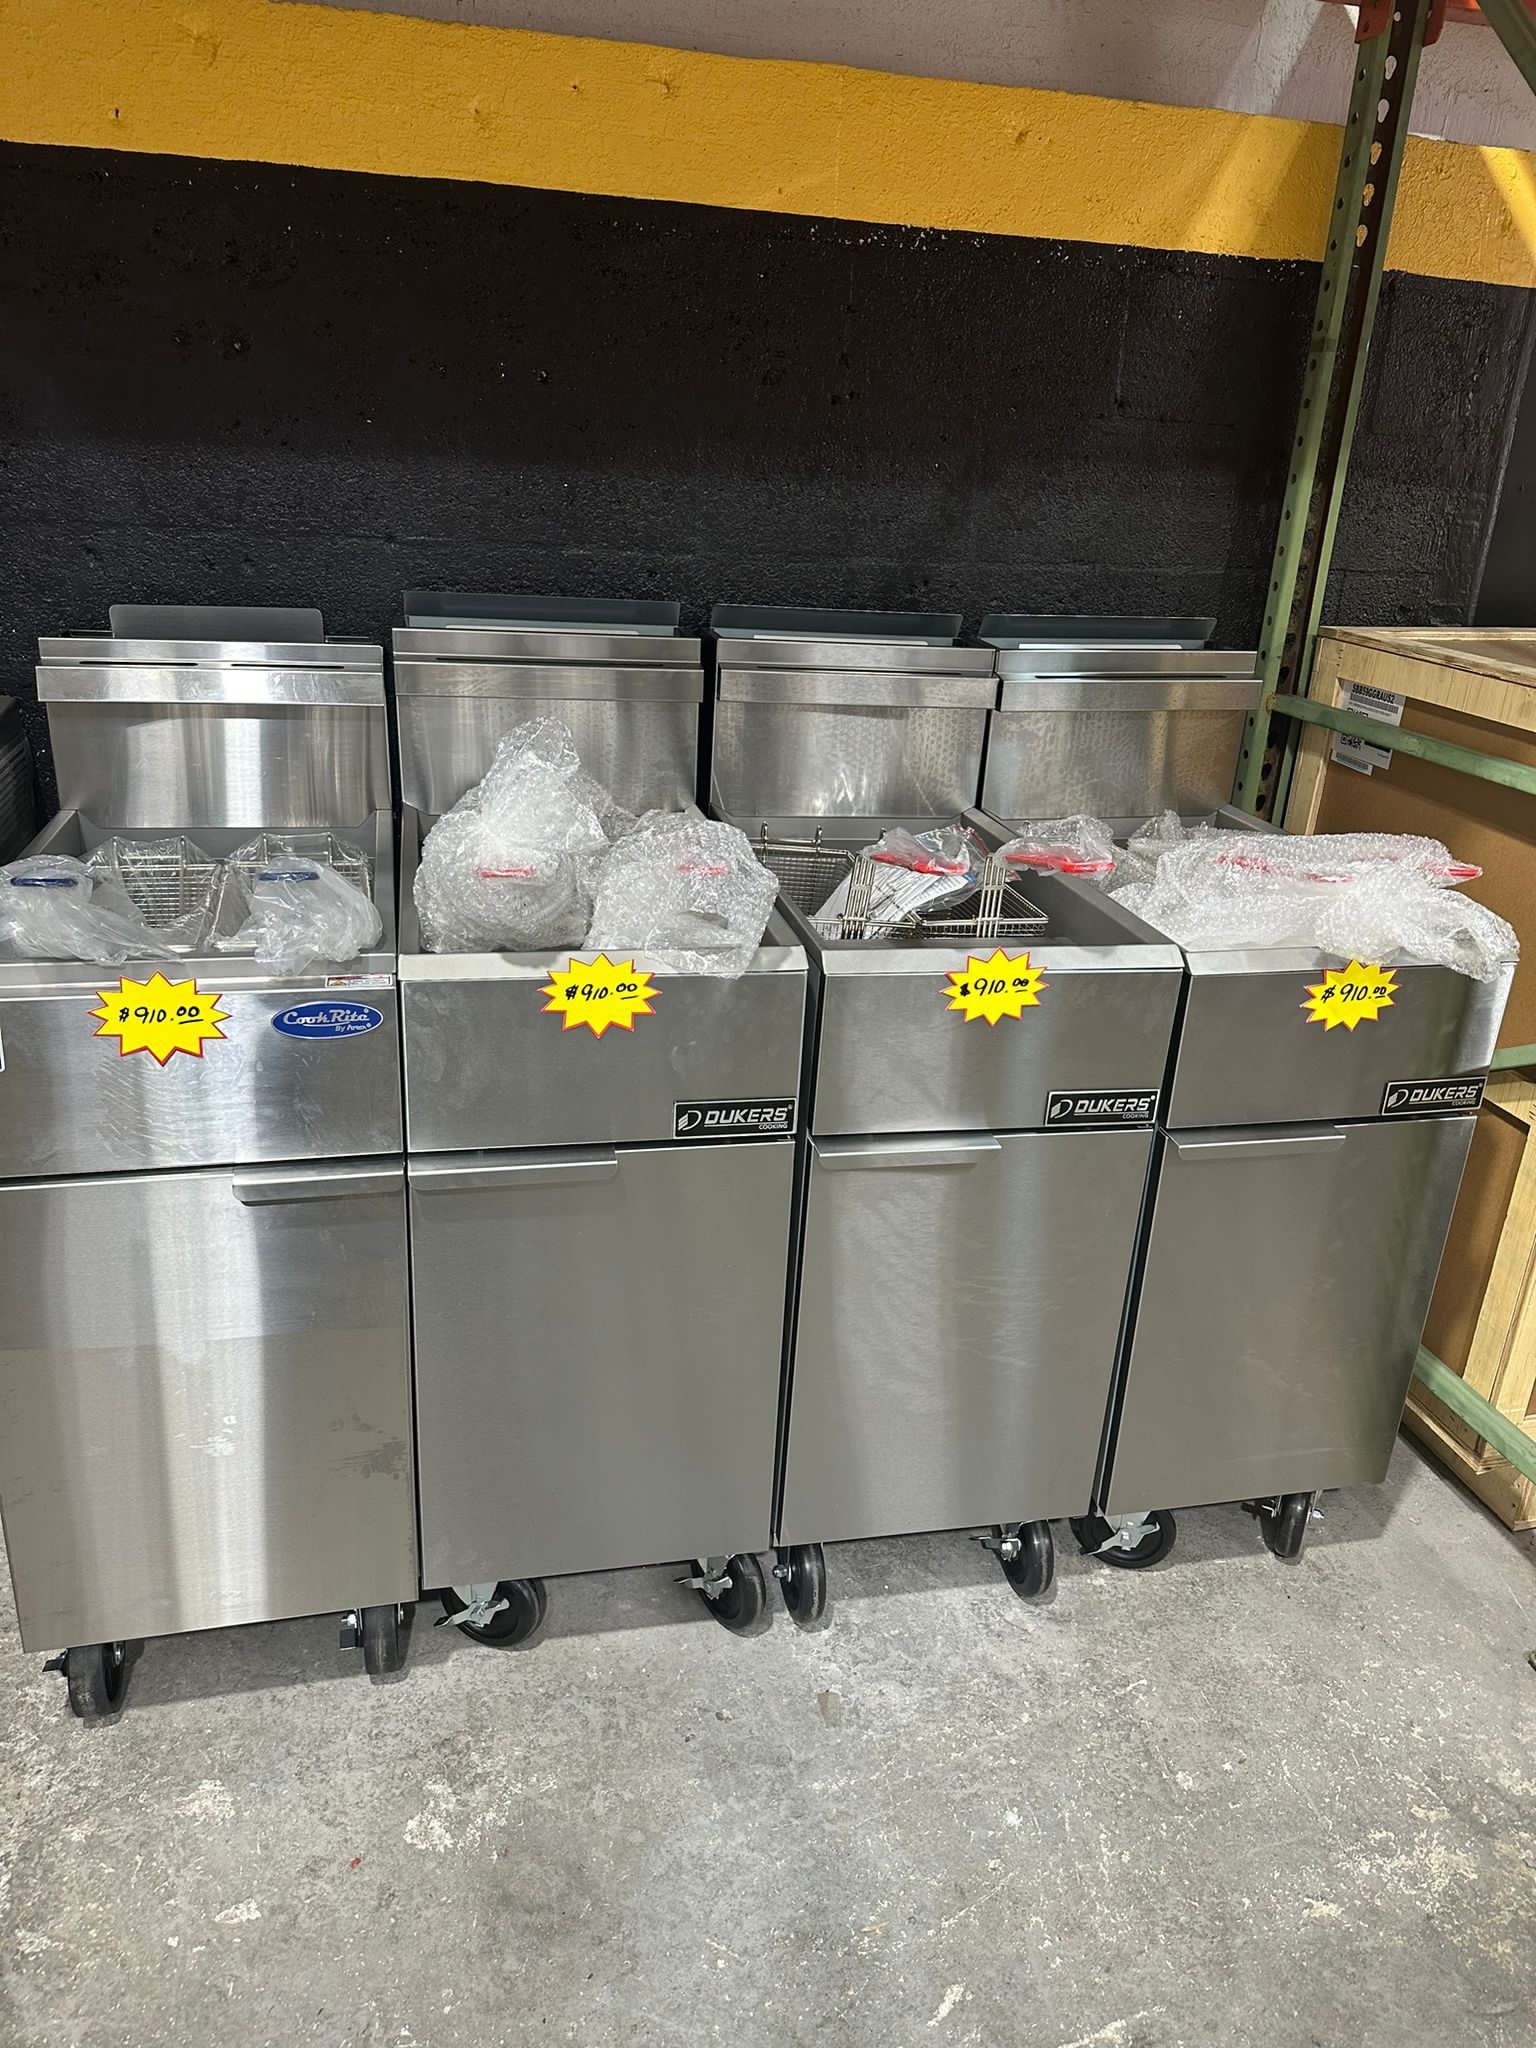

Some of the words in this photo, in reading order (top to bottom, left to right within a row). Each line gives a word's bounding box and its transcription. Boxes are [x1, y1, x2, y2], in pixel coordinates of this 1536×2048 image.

[1410, 1086, 1478, 1102] DUKERS
[1074, 1098, 1151, 1112] DUKERS
[704, 1108, 788, 1124] DUKERS
